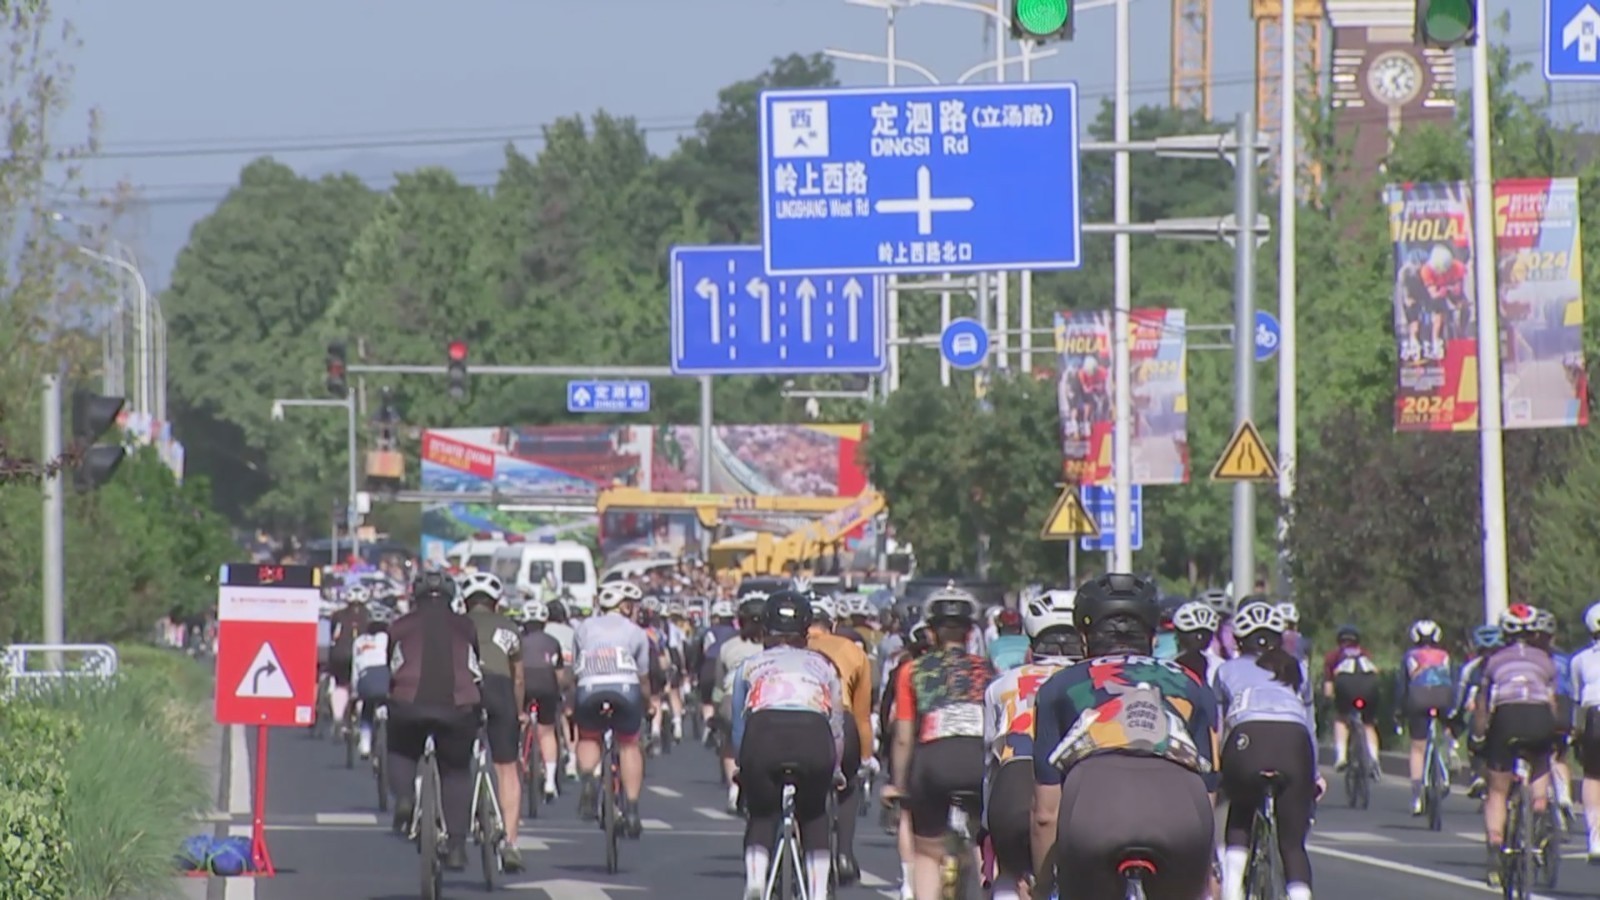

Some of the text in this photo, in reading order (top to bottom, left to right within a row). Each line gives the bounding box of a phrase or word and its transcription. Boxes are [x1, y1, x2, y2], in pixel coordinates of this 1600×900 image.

[870, 99, 967, 136] 定泗路
[871, 135, 968, 157] DINGSI Rd
[774, 161, 868, 197] 岭上西路
[775, 196, 870, 219] LINGSHANG West Rd
[878, 241, 971, 265] 岭上西路北口
[1402, 395, 1456, 414] 2024
